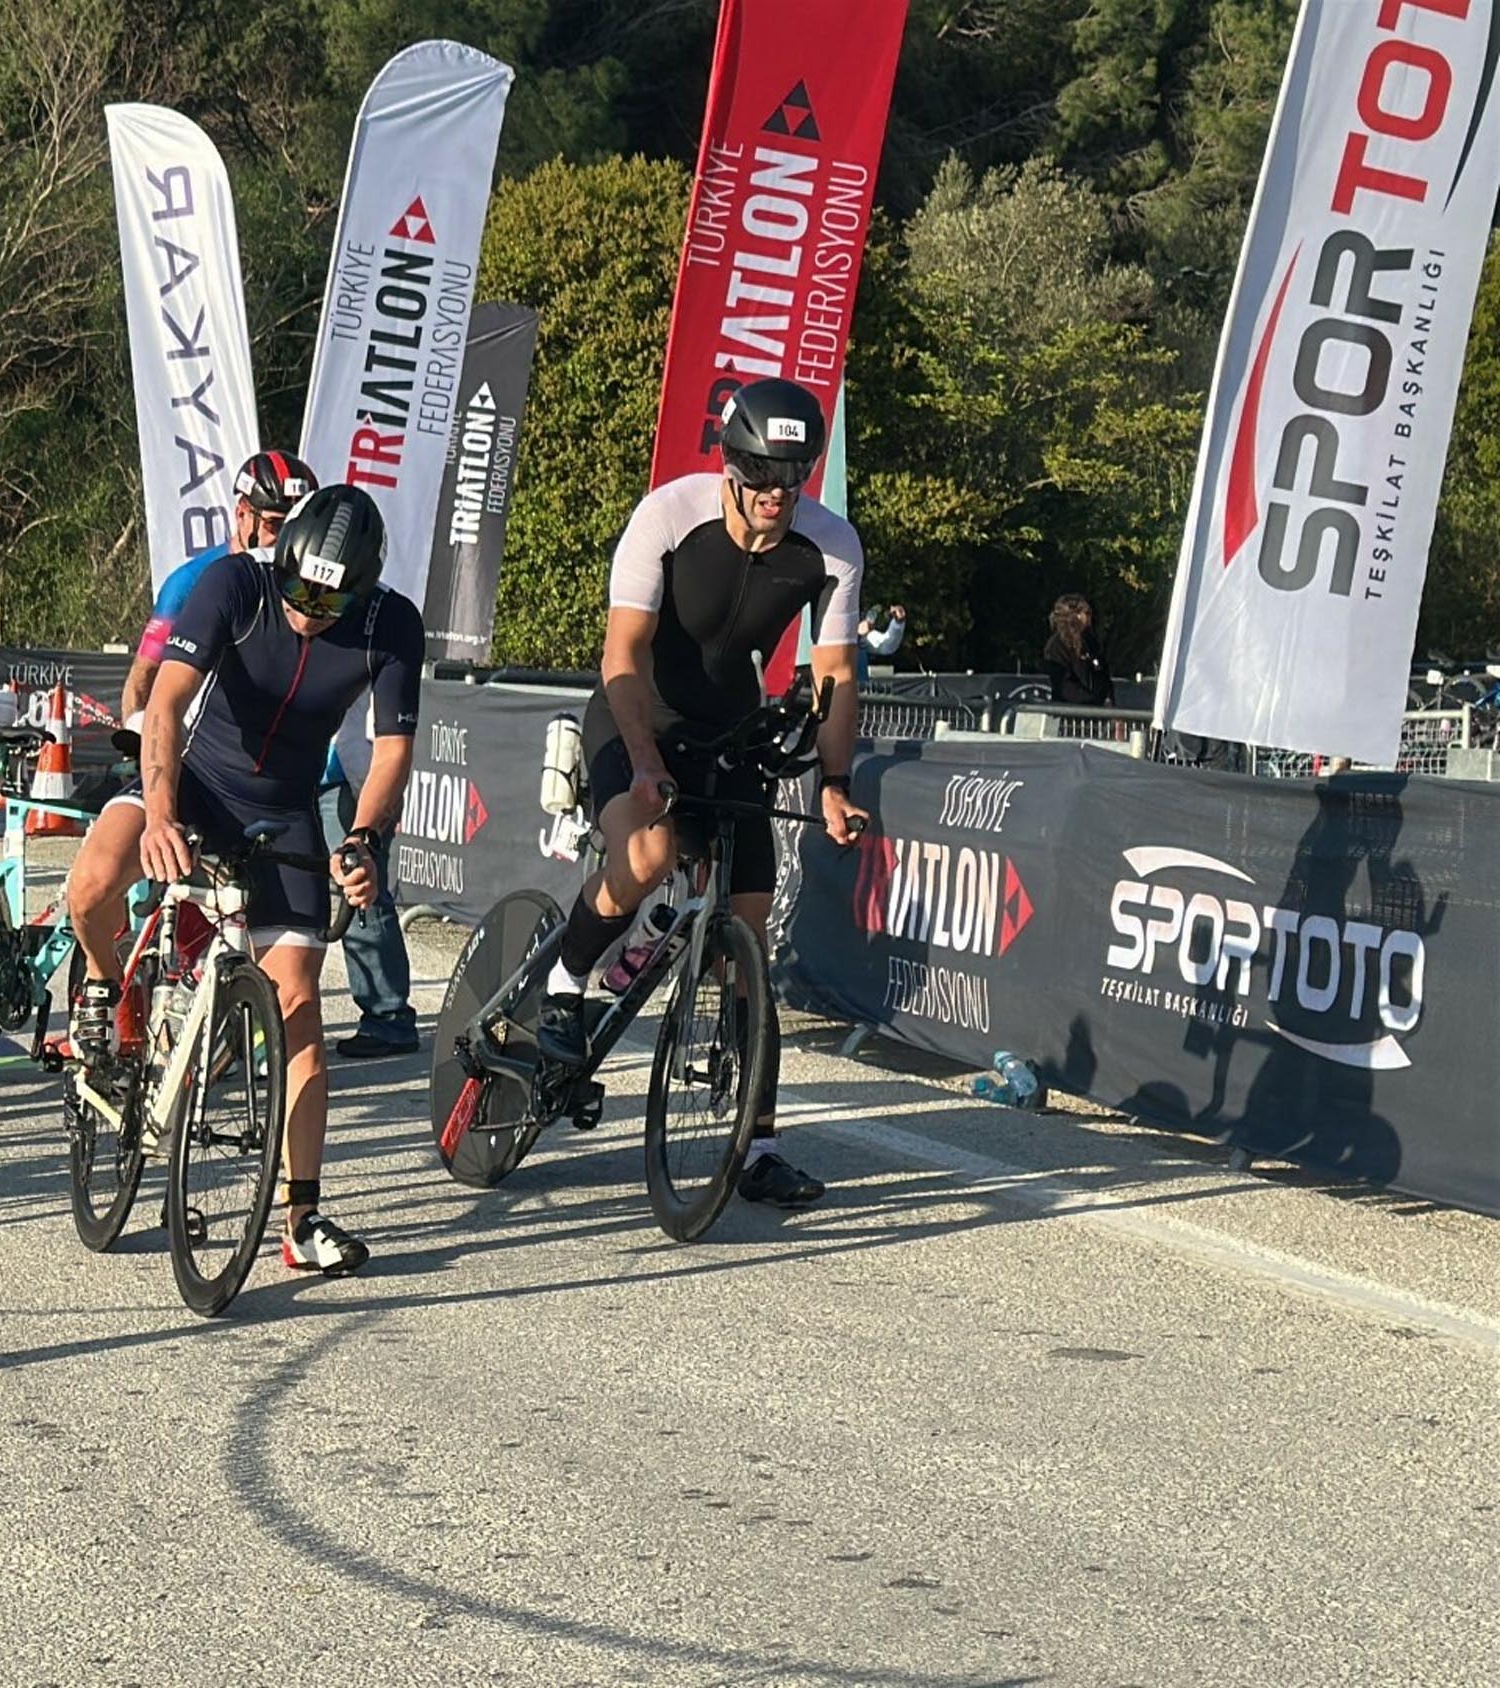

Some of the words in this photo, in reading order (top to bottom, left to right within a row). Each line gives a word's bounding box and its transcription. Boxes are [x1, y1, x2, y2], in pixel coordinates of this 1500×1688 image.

[330, 240, 375, 341] TÜRKİYE
[794, 161, 868, 386] FEDERASYONU
[346, 248, 435, 488] TRIATLON
[417, 260, 472, 436] FEDERASYONU
[778, 424, 799, 438] 104
[1364, 454, 1406, 600] TEŞKİLAT
[1394, 249, 1446, 438] BAŞKANLIĞI
[449, 411, 496, 546] TRIATLON
[487, 416, 517, 515] FEDERASYONU
[311, 563, 335, 582] 117
[8, 662, 75, 687] TÜRKİYE
[431, 720, 468, 766] TÜRKİYE
[400, 770, 467, 845] IATLON
[939, 770, 1023, 832] TÜRKİYE
[399, 845, 463, 895] FEDERASYONU
[883, 956, 990, 1034] FEDERASYONU
[1101, 977, 1160, 1009] TEŞKİLAT
[1164, 993, 1249, 1028] BAŞKANLIĞI
